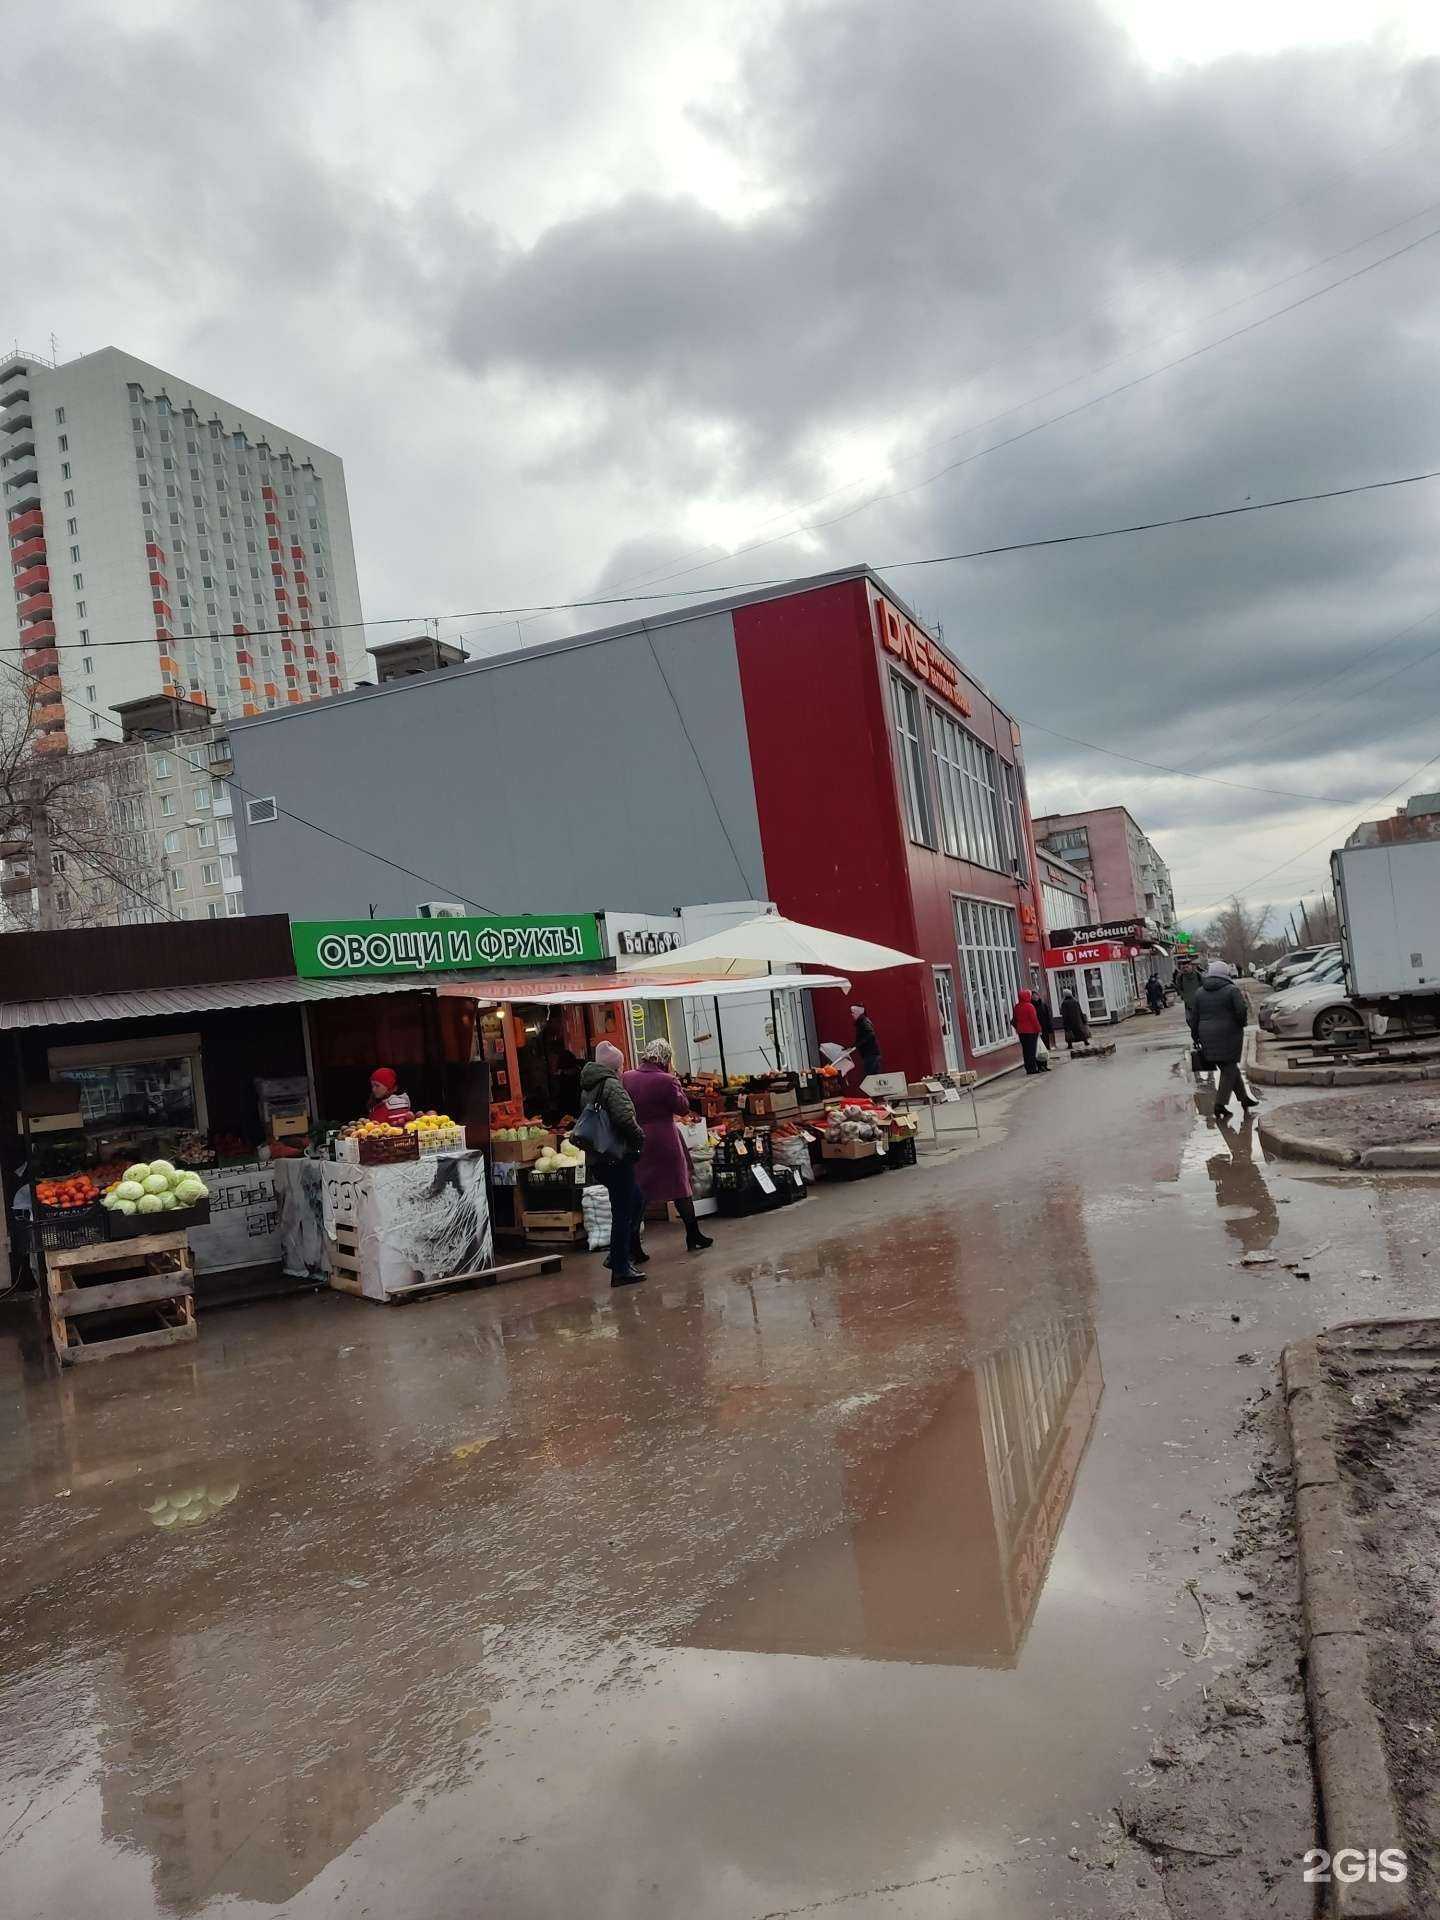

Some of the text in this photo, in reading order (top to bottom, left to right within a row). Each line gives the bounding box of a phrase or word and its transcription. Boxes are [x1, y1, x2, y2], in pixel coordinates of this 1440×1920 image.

[876, 598, 930, 679] DNS
[317, 926, 584, 969] ОВОЩИ И ФРУКТЫ
[1078, 948, 1100, 959] МТС
